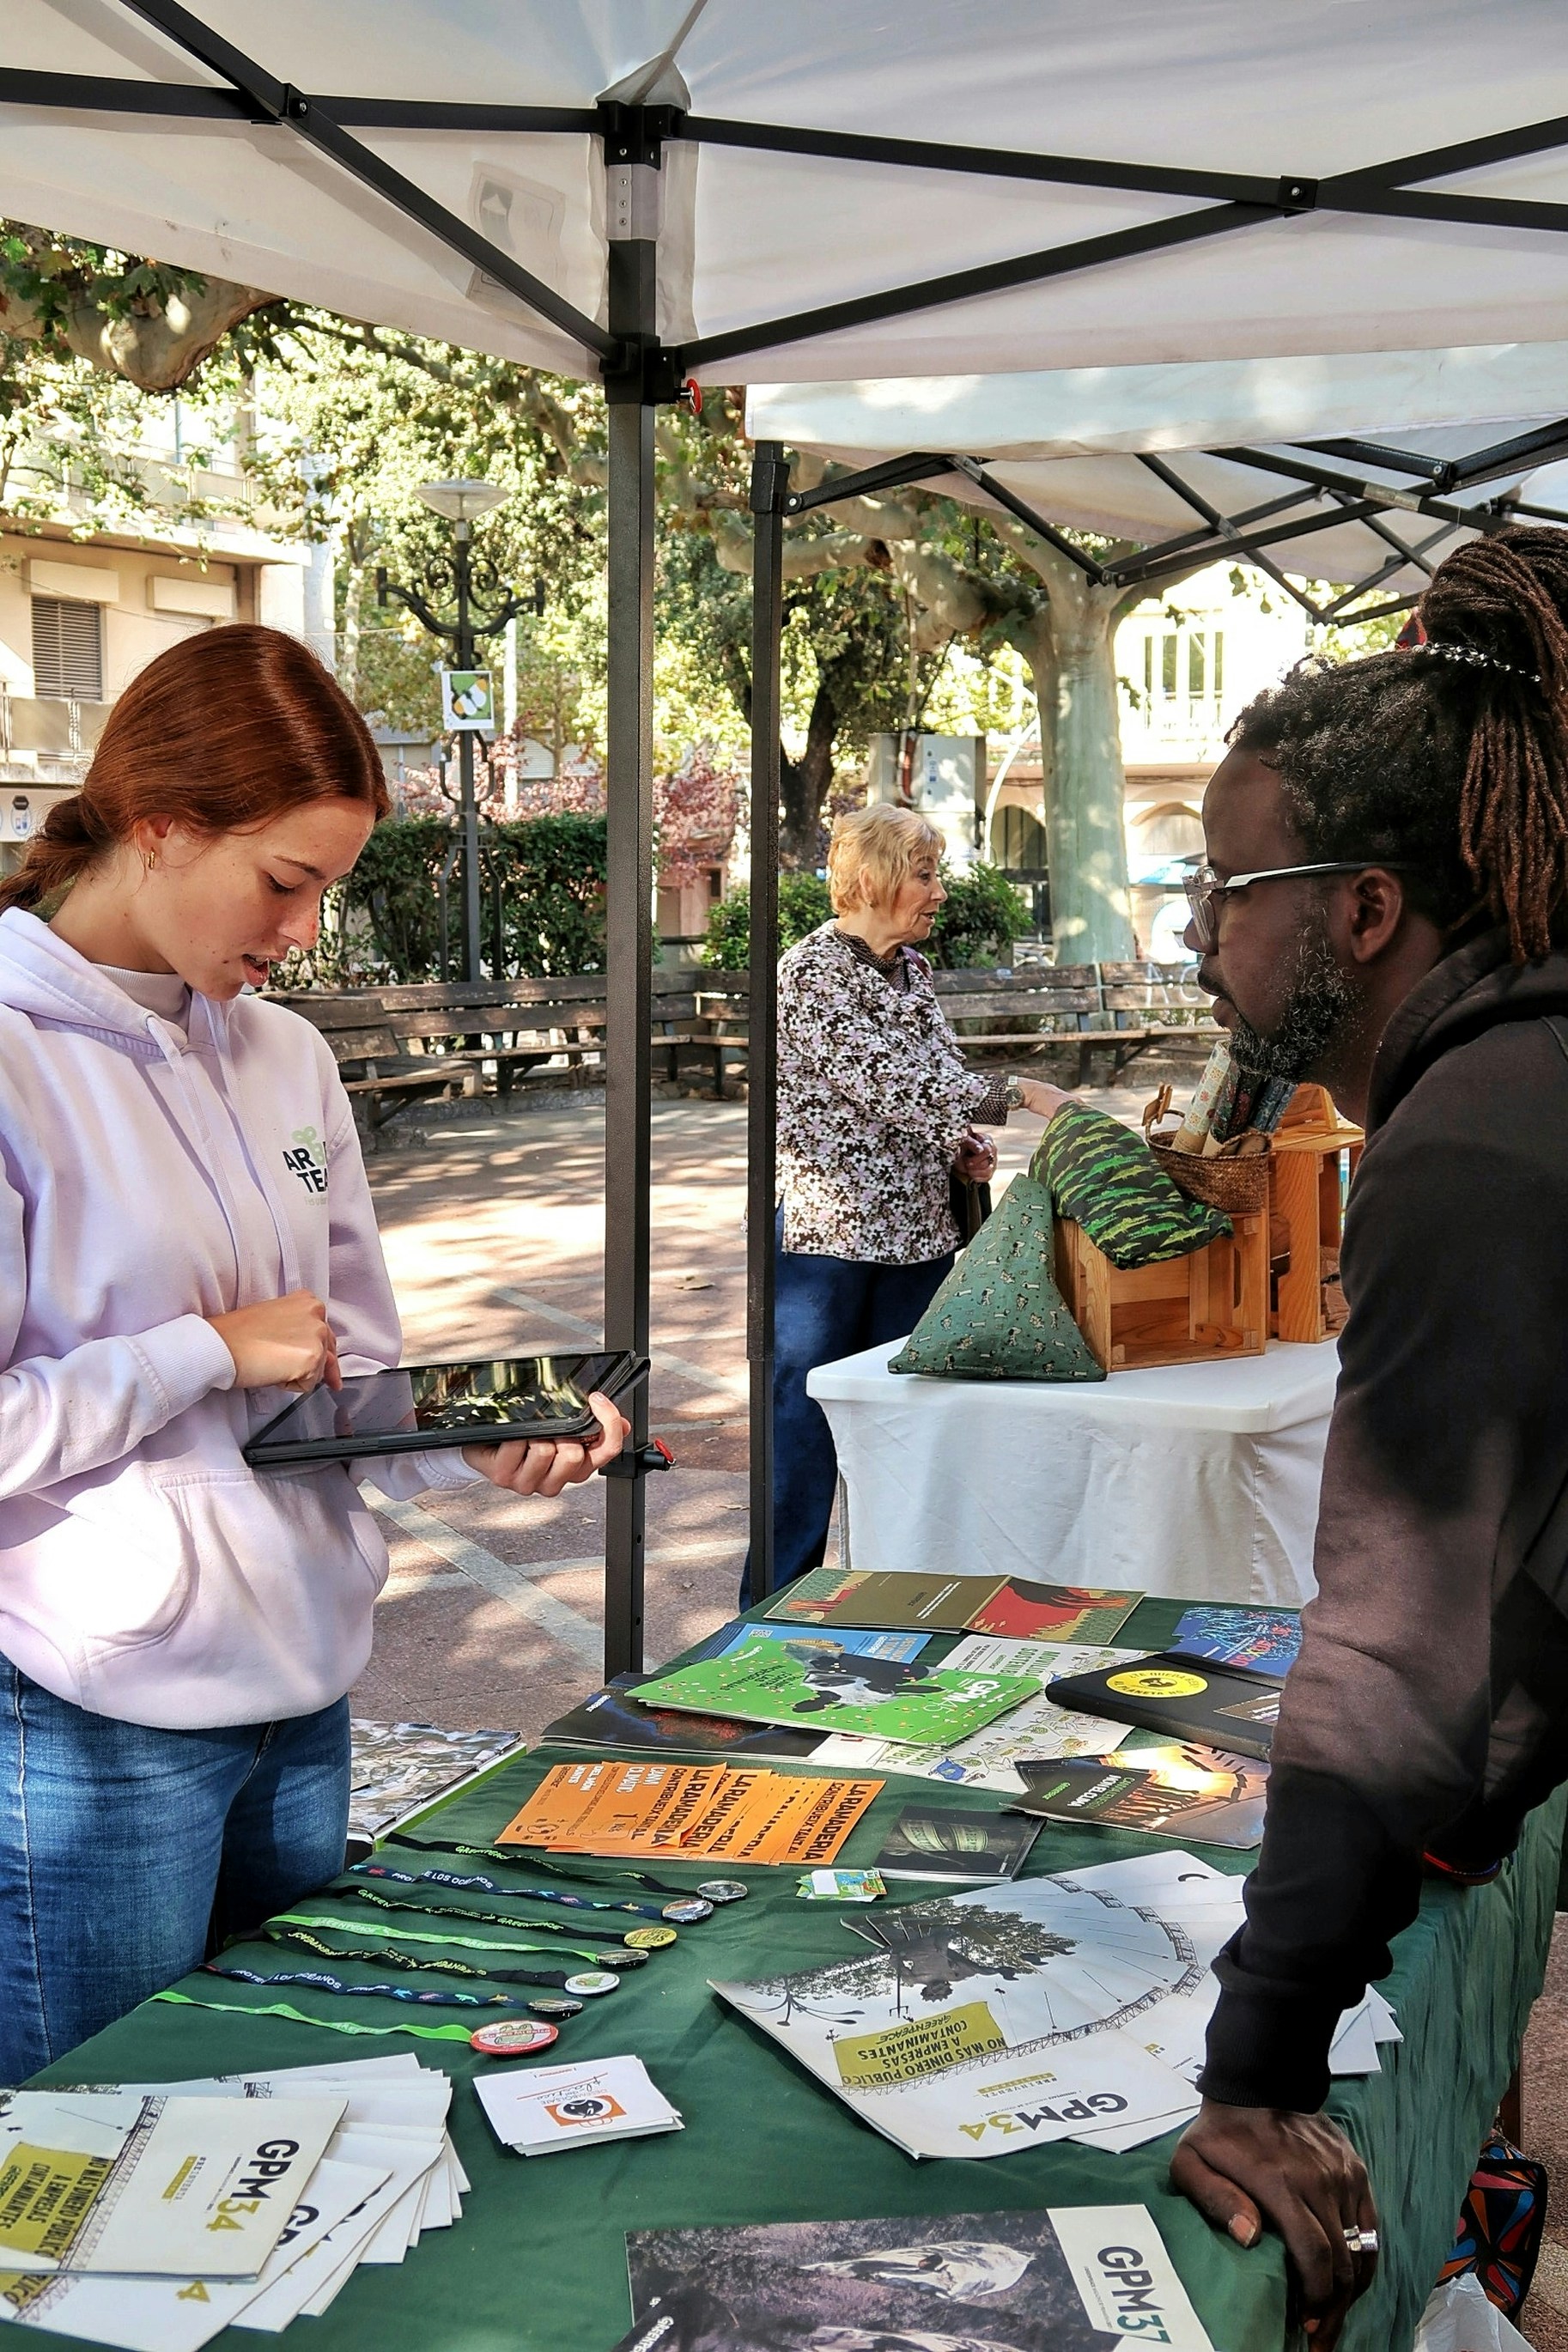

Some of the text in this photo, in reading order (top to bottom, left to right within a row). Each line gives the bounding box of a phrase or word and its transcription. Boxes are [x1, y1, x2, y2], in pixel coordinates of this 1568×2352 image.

[650, 1767, 687, 1814] CONTRIBUEIX
[733, 1774, 757, 1788] LA
[651, 1769, 714, 1845] LA RAMADERIA
[678, 1788, 747, 1849] RAMADERIA
[802, 1784, 872, 1861] LA RAMADERIA
[631, 1827, 645, 1839] AL
[432, 1872, 451, 1881] LOS
[857, 2020, 969, 2061] CONTAMINANTES
[876, 2015, 952, 2045] GREENPEACE
[987, 2036, 1006, 2050] NO
[883, 2037, 961, 2069] A EMPRESAS
[904, 2053, 955, 2075] DINERO
[957, 2093, 1129, 2142] GPM34
[88, 2155, 110, 2169] NO
[27, 2173, 73, 2224] A EMPRESAS
[59, 2187, 94, 2218] DINERO
[206, 2139, 300, 2232] GPM34
[1097, 2246, 1174, 2345] GPM37
